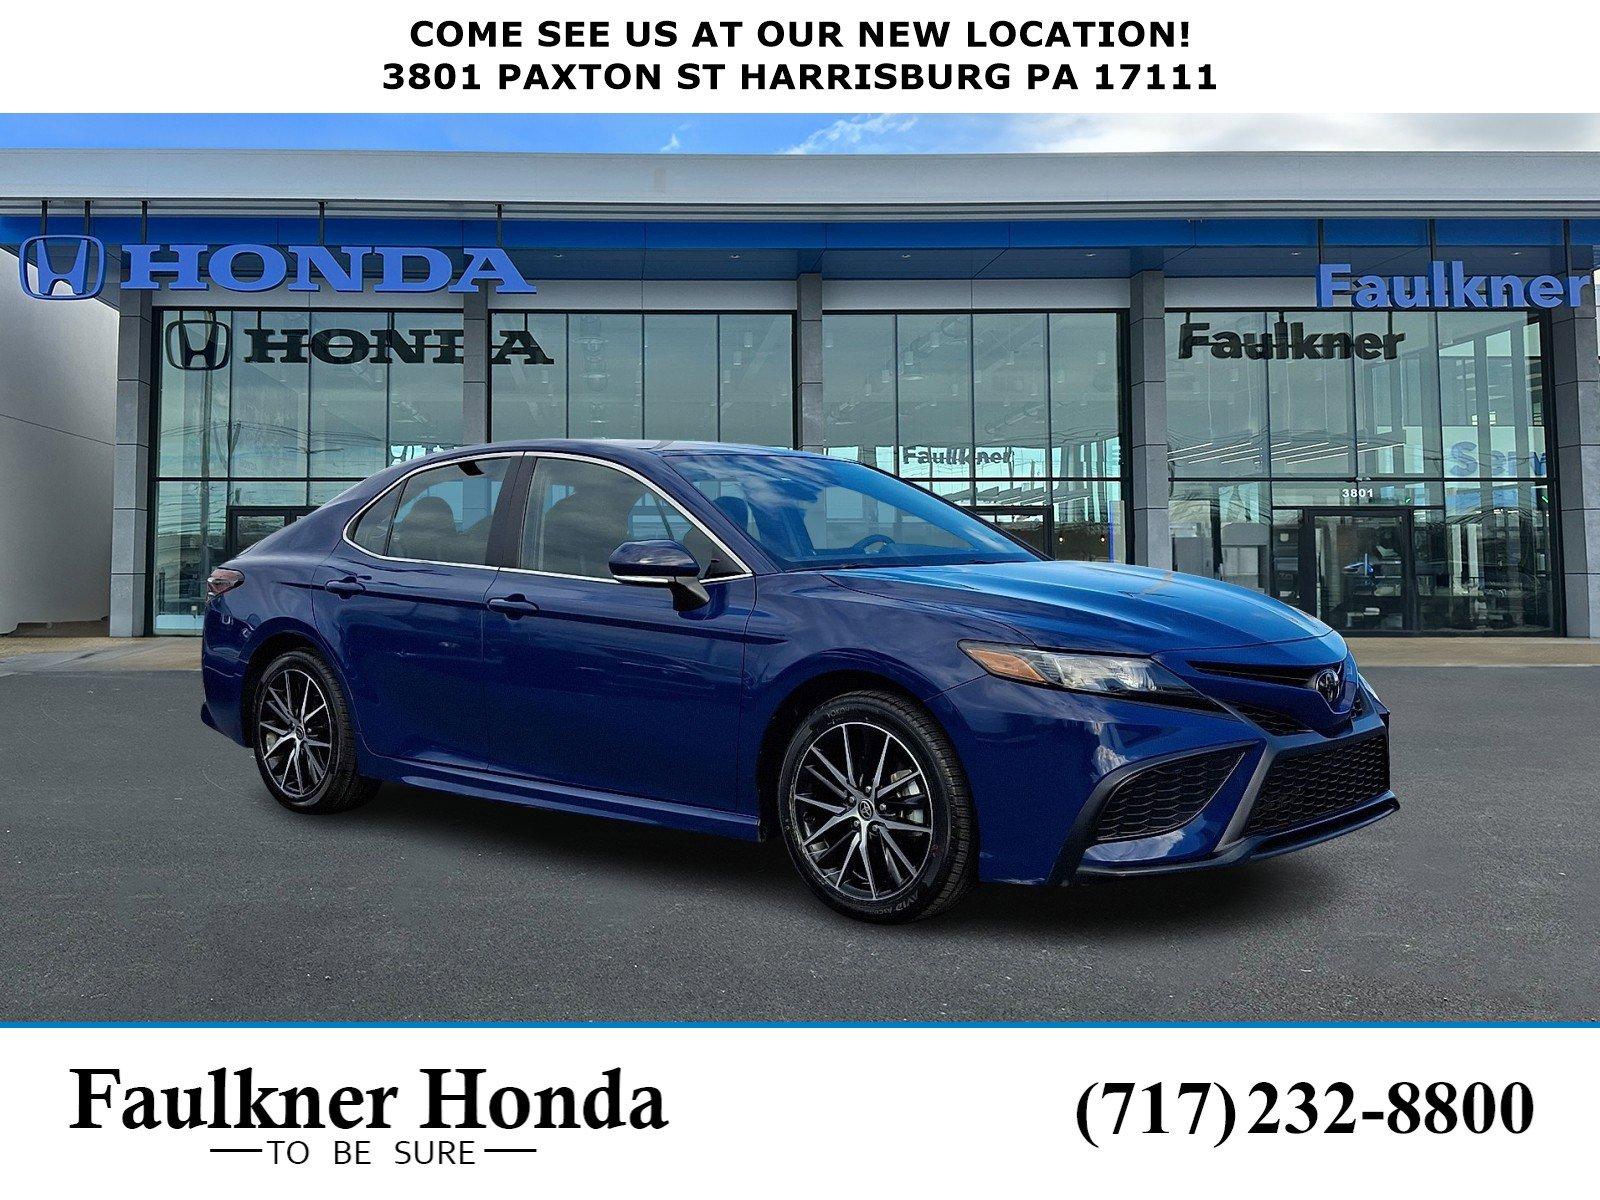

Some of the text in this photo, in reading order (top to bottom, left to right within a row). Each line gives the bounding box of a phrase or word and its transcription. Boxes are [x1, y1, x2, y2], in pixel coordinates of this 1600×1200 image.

[120, 243, 537, 295] HONDA
[1317, 260, 1591, 309] Faulkner
[1179, 322, 1405, 361] Faulkner
[1342, 488, 1374, 498] 3801
